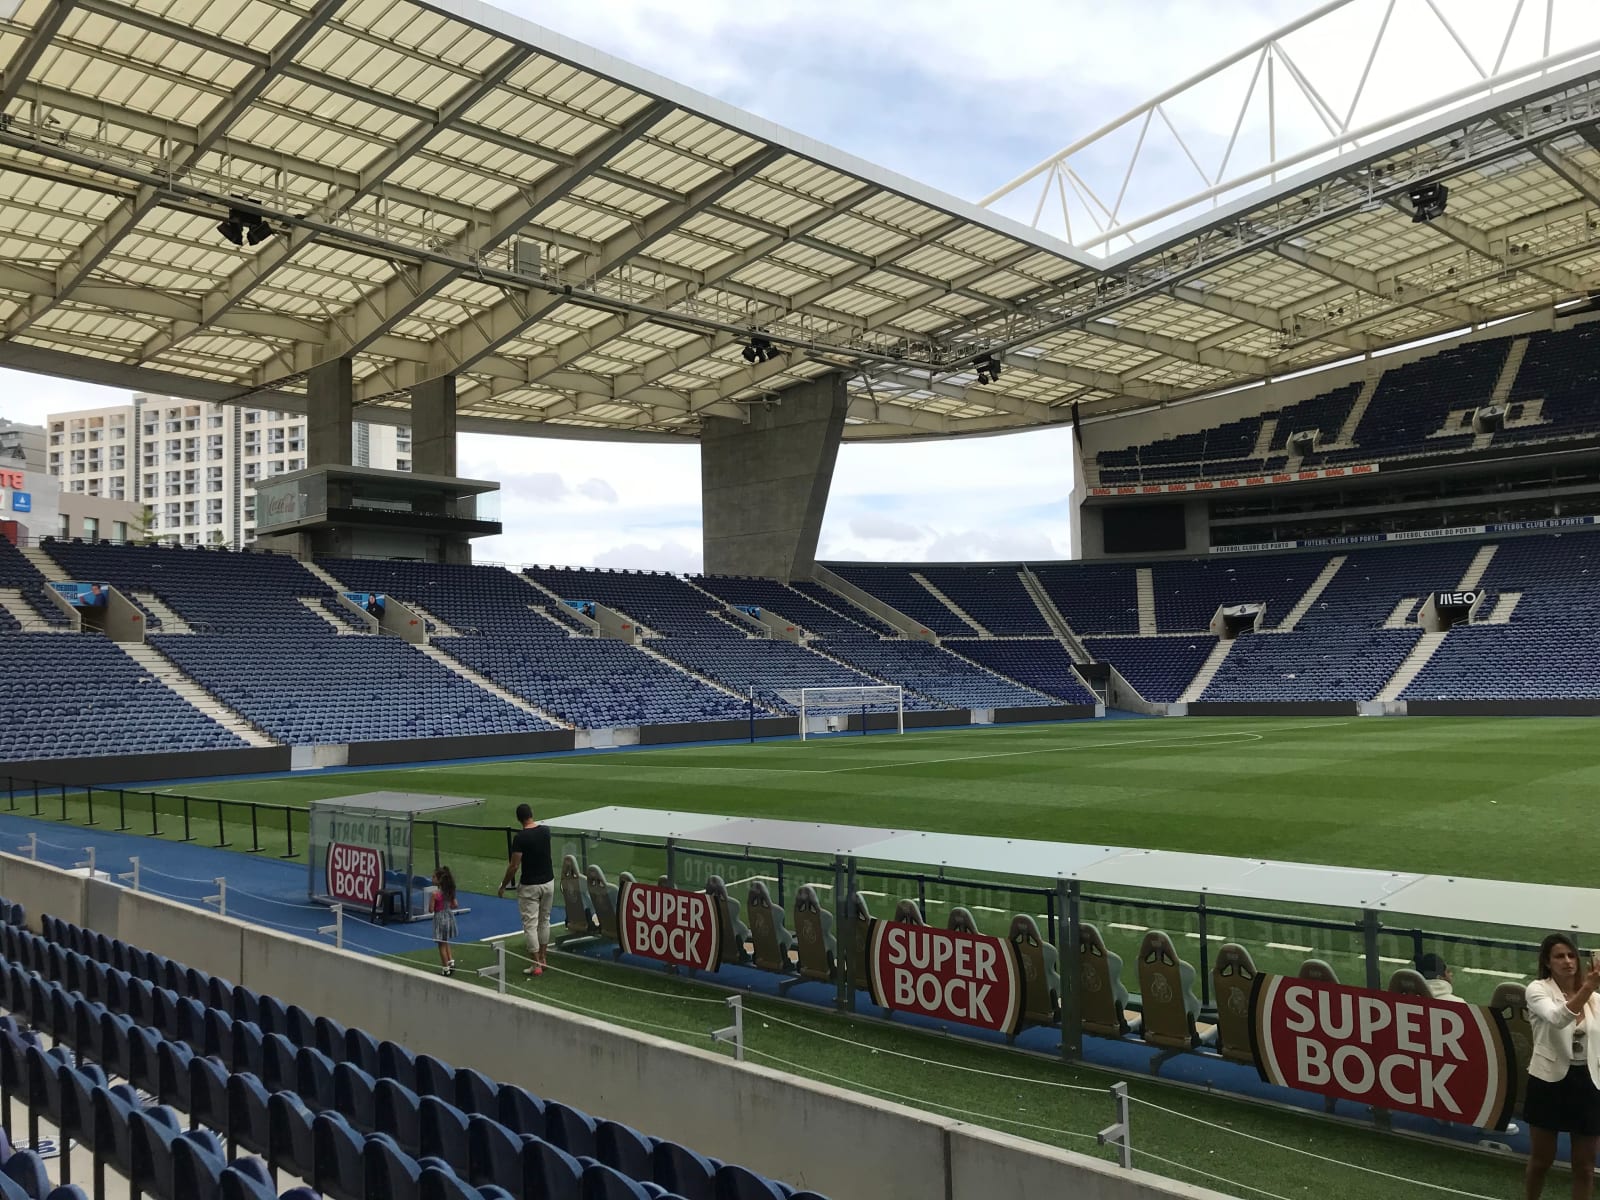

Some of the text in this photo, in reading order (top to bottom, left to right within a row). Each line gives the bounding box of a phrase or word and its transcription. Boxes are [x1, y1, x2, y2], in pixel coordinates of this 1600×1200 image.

[1440, 592, 1476, 604] MEO
[334, 847, 376, 877] SUPER
[335, 871, 374, 902] BOCK
[632, 888, 705, 931] SUPER
[635, 920, 702, 964] BOCK
[888, 928, 999, 983] SUPER
[894, 967, 994, 1024] BOCK
[1284, 985, 1469, 1062] SUPER
[1296, 1035, 1463, 1115] BOCK
